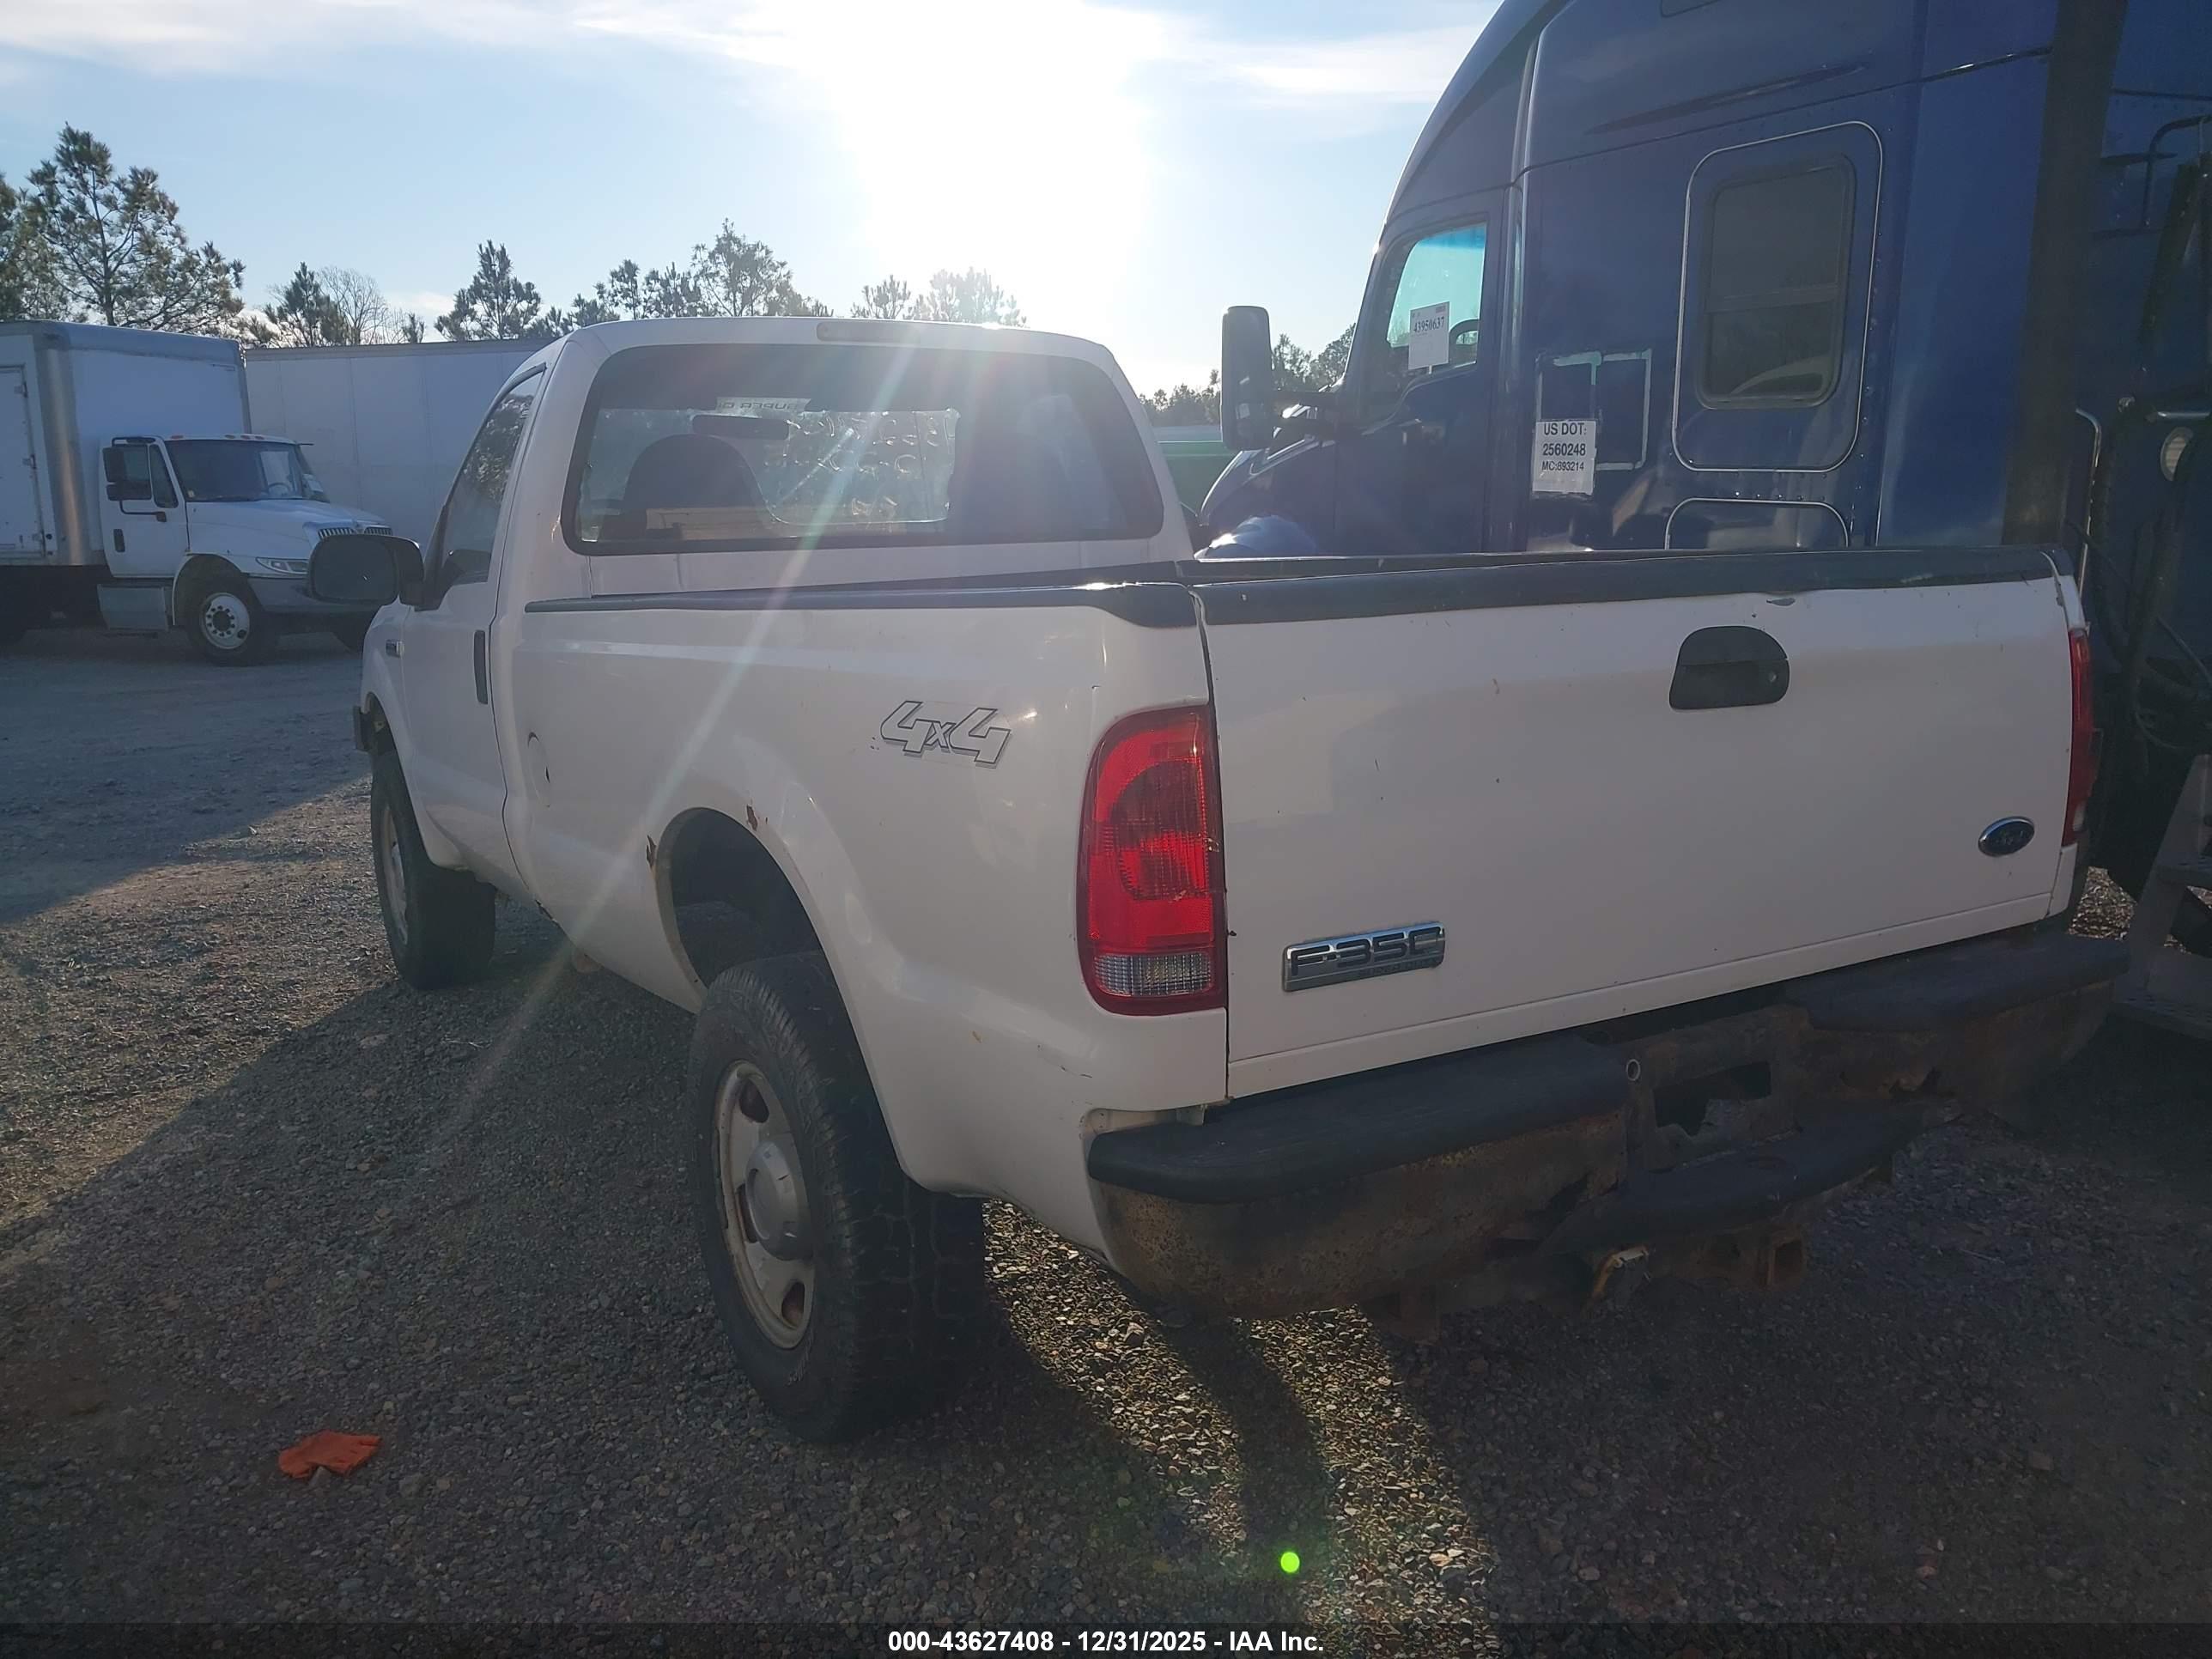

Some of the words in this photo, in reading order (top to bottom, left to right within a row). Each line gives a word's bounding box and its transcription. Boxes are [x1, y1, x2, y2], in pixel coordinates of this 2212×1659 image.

[1413, 316, 1445, 333] 43950637
[1543, 422, 1559, 435] US
[1561, 422, 1587, 435] DOT:
[1542, 443, 1586, 456] 2560248
[1541, 460, 1584, 471] MC:893214
